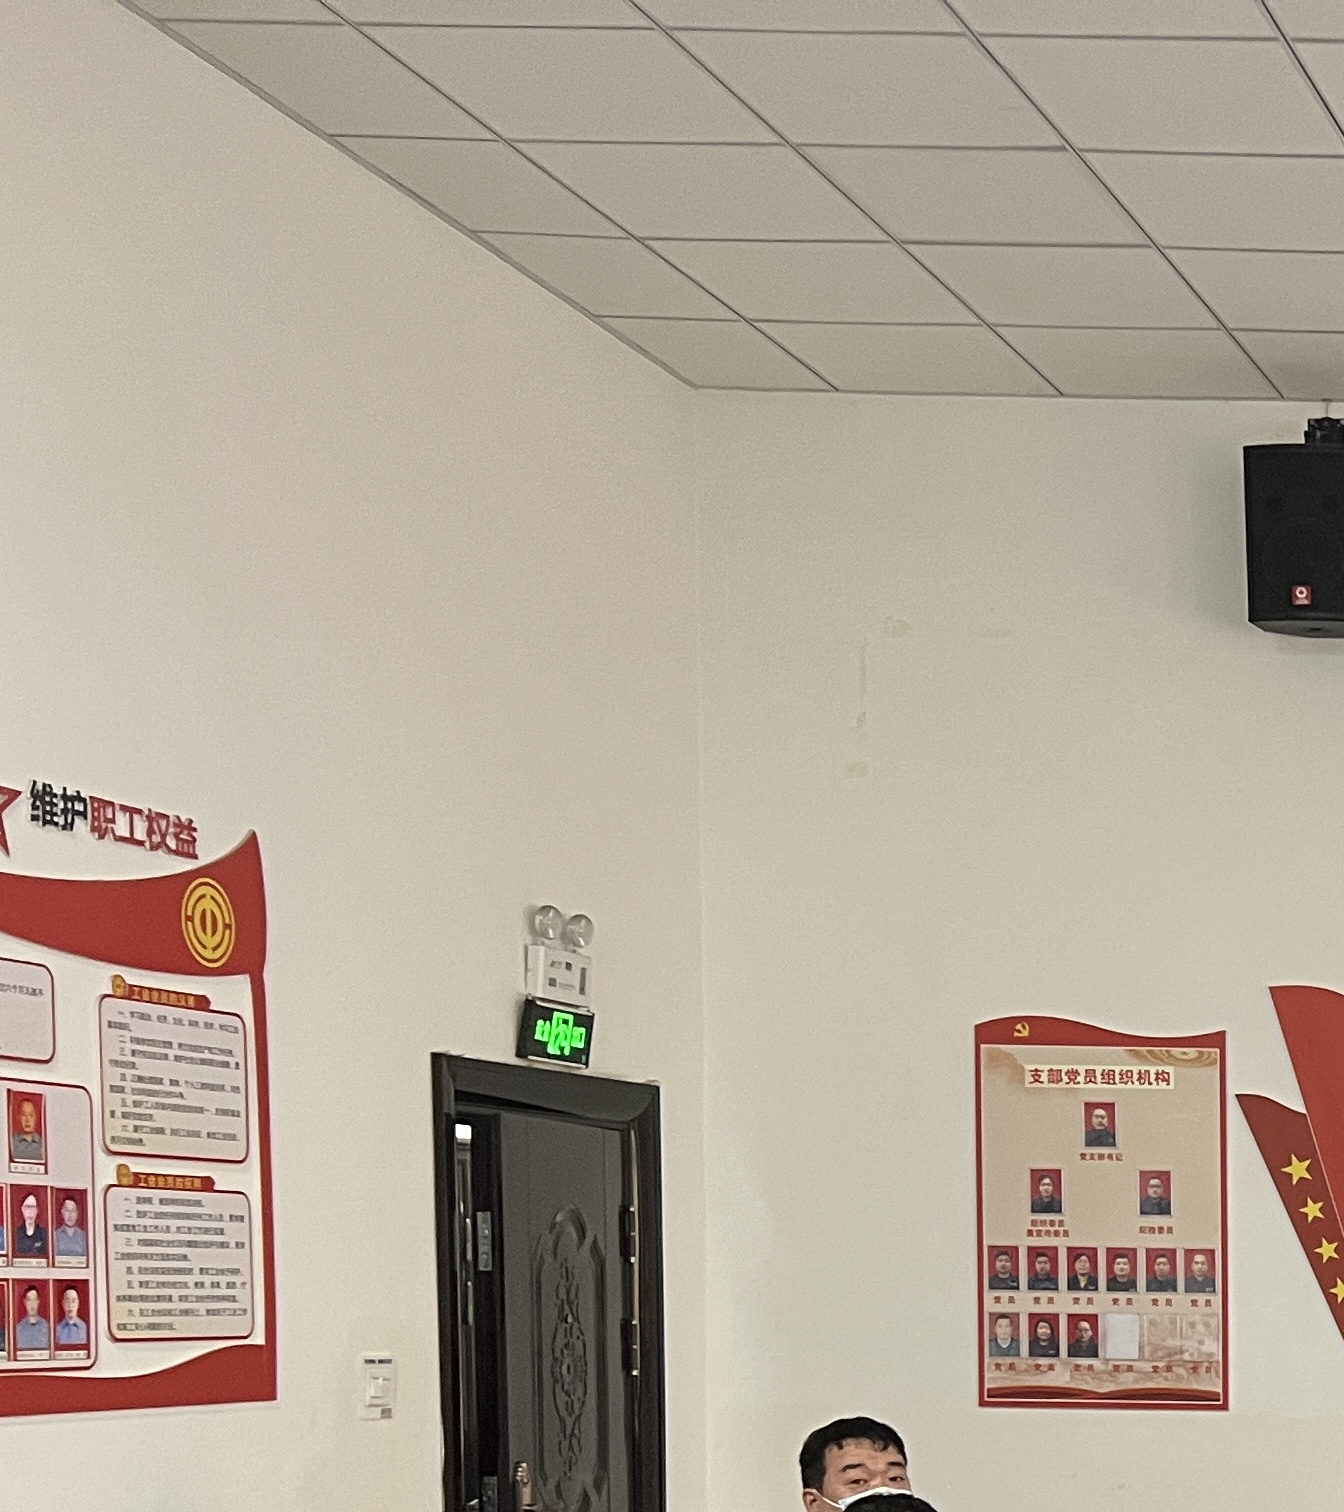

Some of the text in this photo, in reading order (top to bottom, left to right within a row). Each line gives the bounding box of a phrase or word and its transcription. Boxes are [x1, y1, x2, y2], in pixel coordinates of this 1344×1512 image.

[29, 779, 199, 860] 维护职工权益
[1028, 1067, 1171, 1086] 支部党员组织机构
